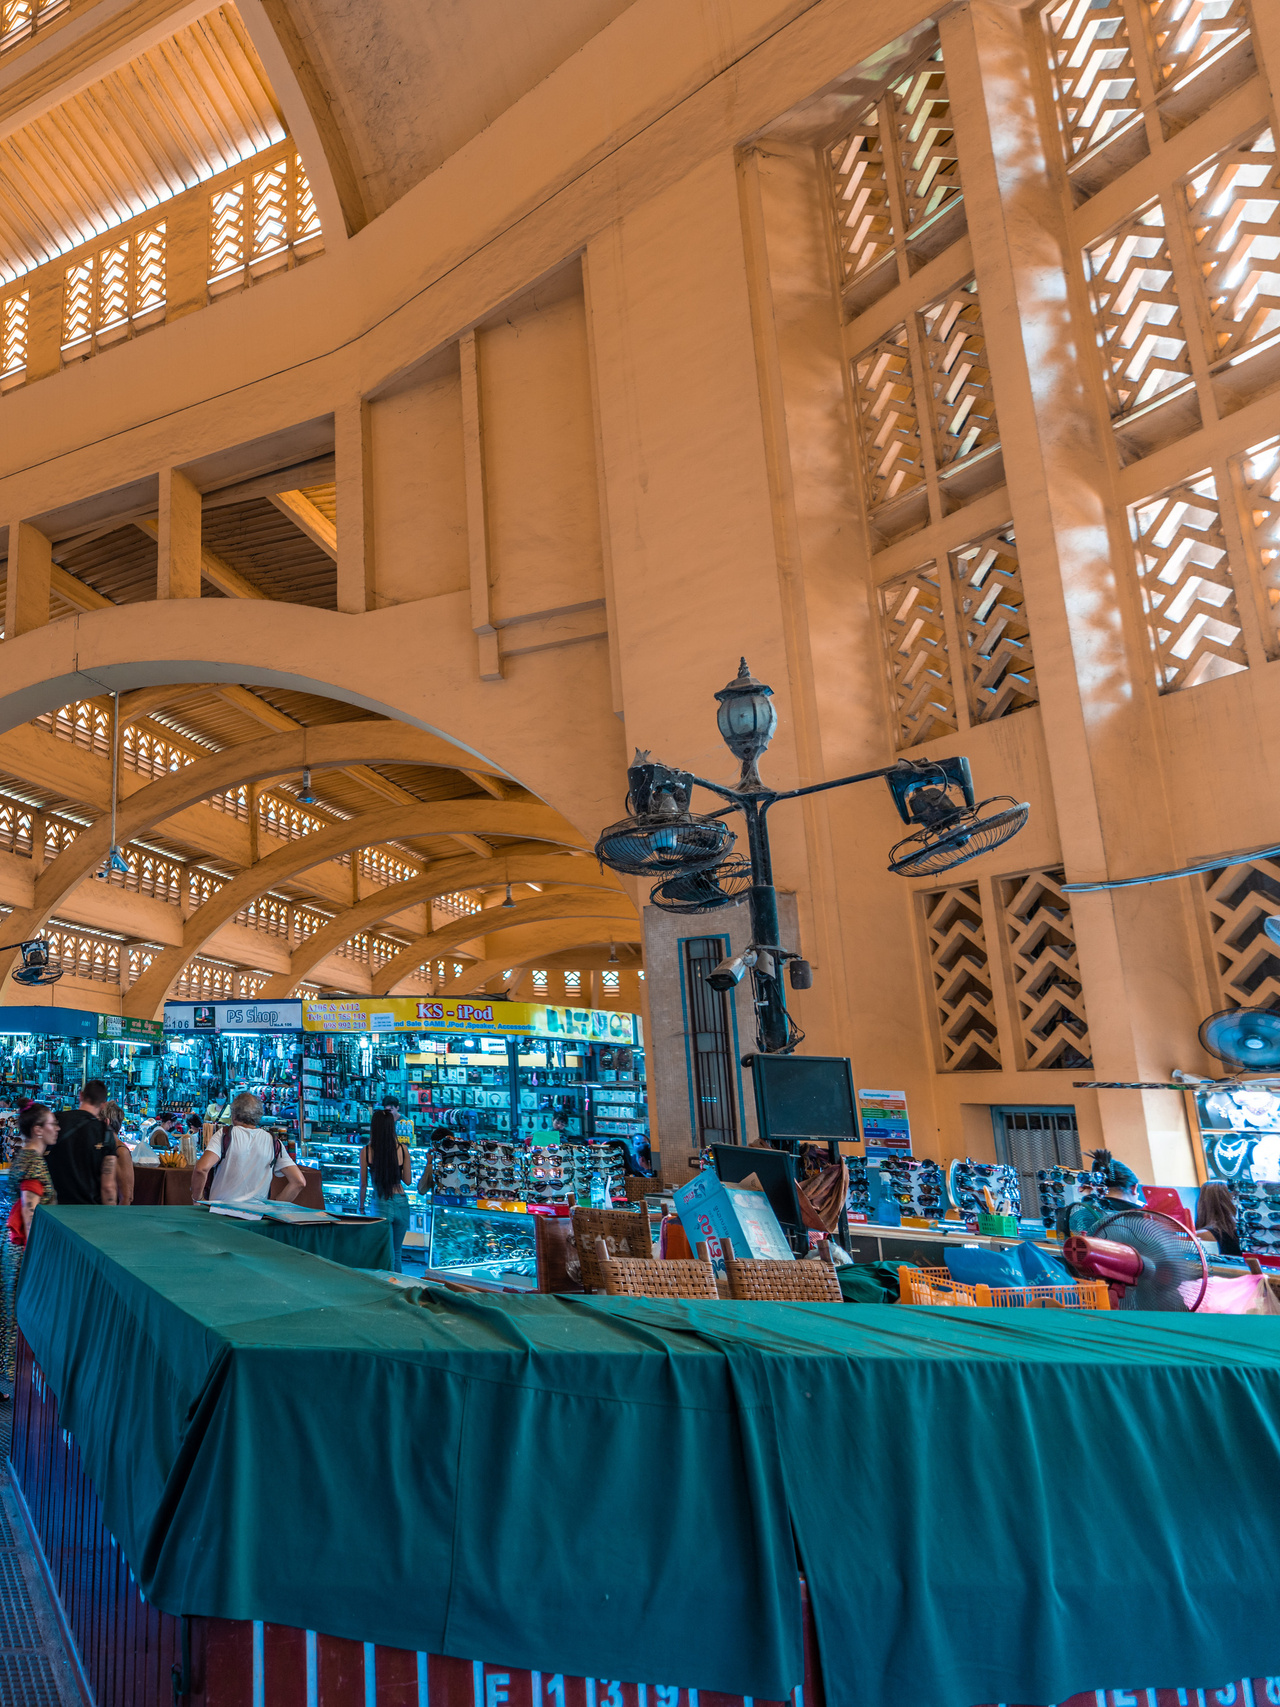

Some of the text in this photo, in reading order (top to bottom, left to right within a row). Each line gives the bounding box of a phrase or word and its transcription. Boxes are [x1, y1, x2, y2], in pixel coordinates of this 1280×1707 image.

[329, 1003, 337, 1012] &
[338, 1003, 360, 1011] A112
[416, 1002, 444, 1019] KS
[457, 1004, 494, 1021] iPod
[226, 1006, 279, 1026] PS Shop
[306, 1013, 322, 1021] Tel:
[172, 1020, 190, 1029] 106
[423, 1020, 446, 1028] GAME
